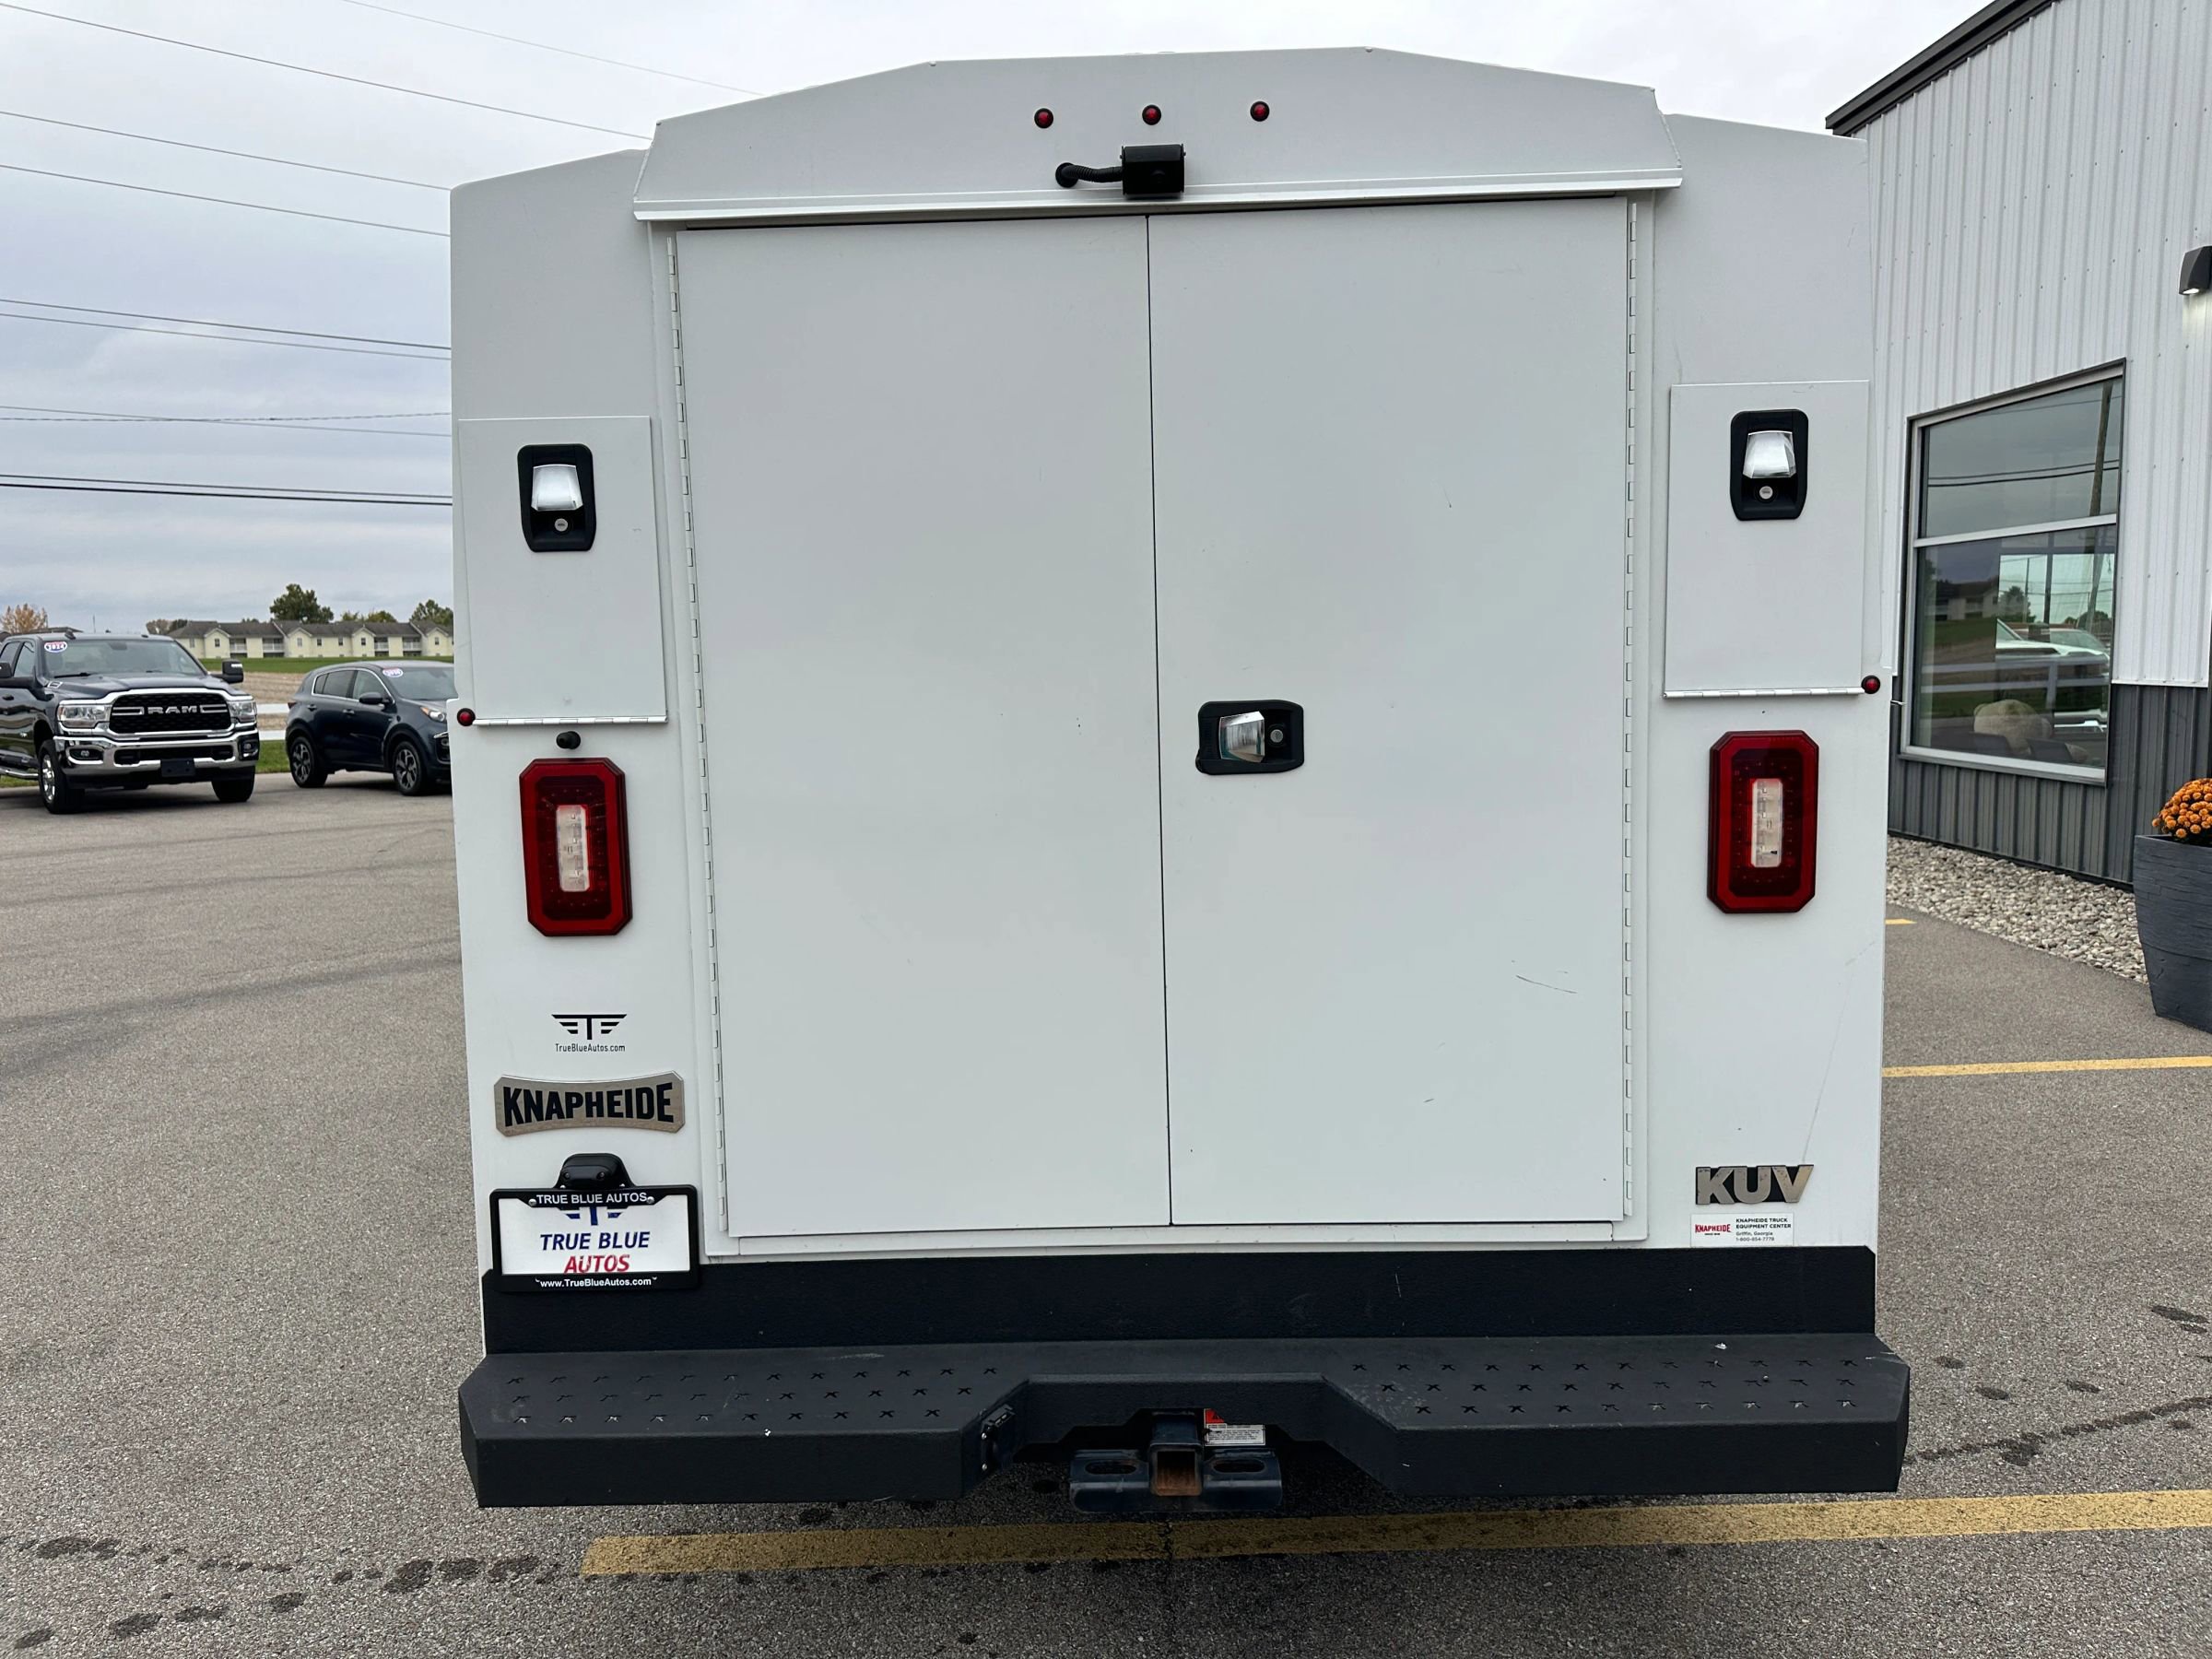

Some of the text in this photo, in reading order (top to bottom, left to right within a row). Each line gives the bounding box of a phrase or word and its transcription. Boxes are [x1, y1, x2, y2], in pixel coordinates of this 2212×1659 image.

[147, 705, 197, 714] RAM
[555, 1043, 626, 1053] TrueBlueAutos.com
[502, 1081, 675, 1127] KNAPHEIDE
[1695, 1164, 1814, 1205] KUV
[536, 1192, 647, 1205] TRUE BLUE AUTOS
[1695, 1224, 1731, 1233] KNAPHEIDE
[539, 1230, 651, 1251] TRUE BLUE
[563, 1253, 630, 1274] AUTOS
[539, 1276, 653, 1288] www.TrueBlueAutos.com
